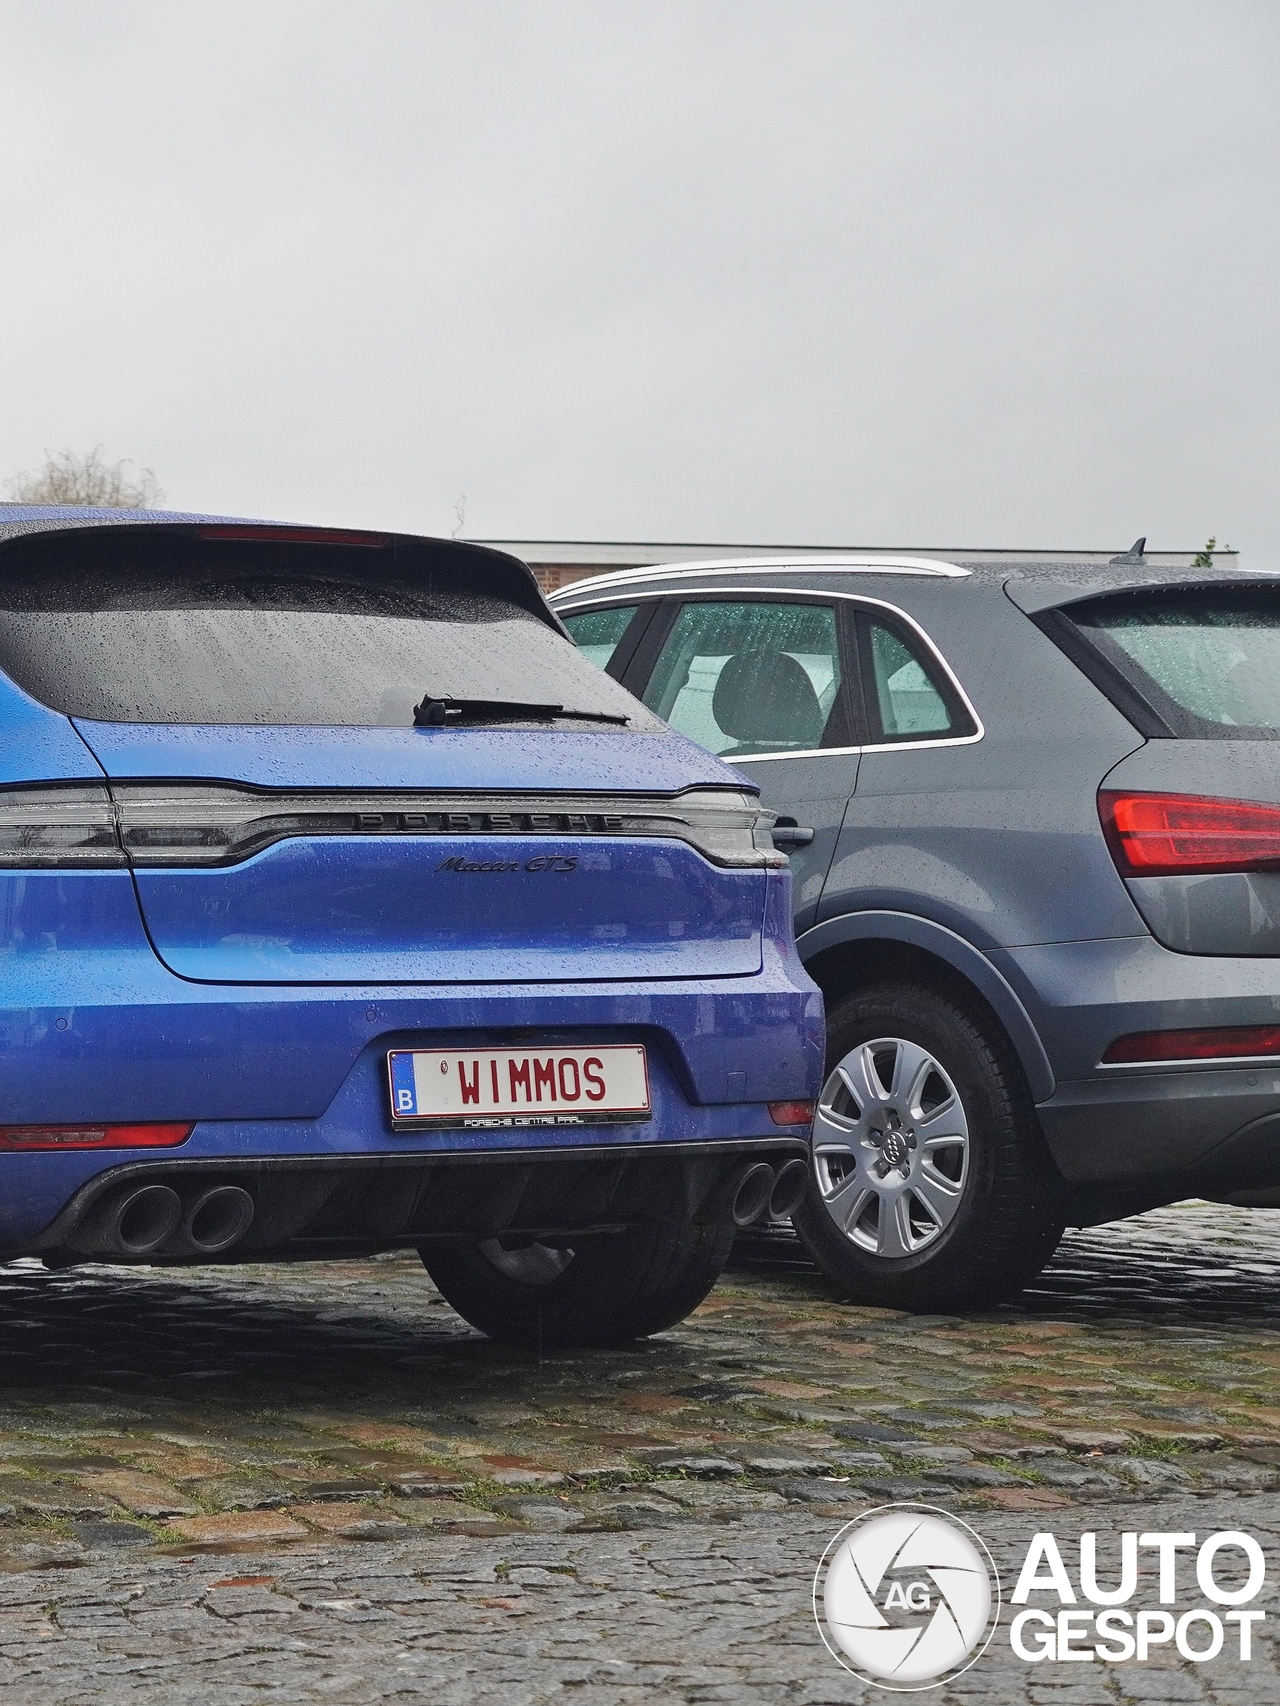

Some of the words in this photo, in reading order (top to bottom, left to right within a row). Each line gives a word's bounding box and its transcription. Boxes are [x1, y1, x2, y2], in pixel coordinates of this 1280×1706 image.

[354, 813, 624, 832] PORSCHE
[435, 855, 519, 873] Macan
[524, 854, 579, 873] GTS
[457, 1056, 607, 1105] WIMMOS
[397, 1089, 414, 1110] B
[464, 1118, 513, 1127] PORSCHE
[515, 1116, 555, 1125] CENTRE
